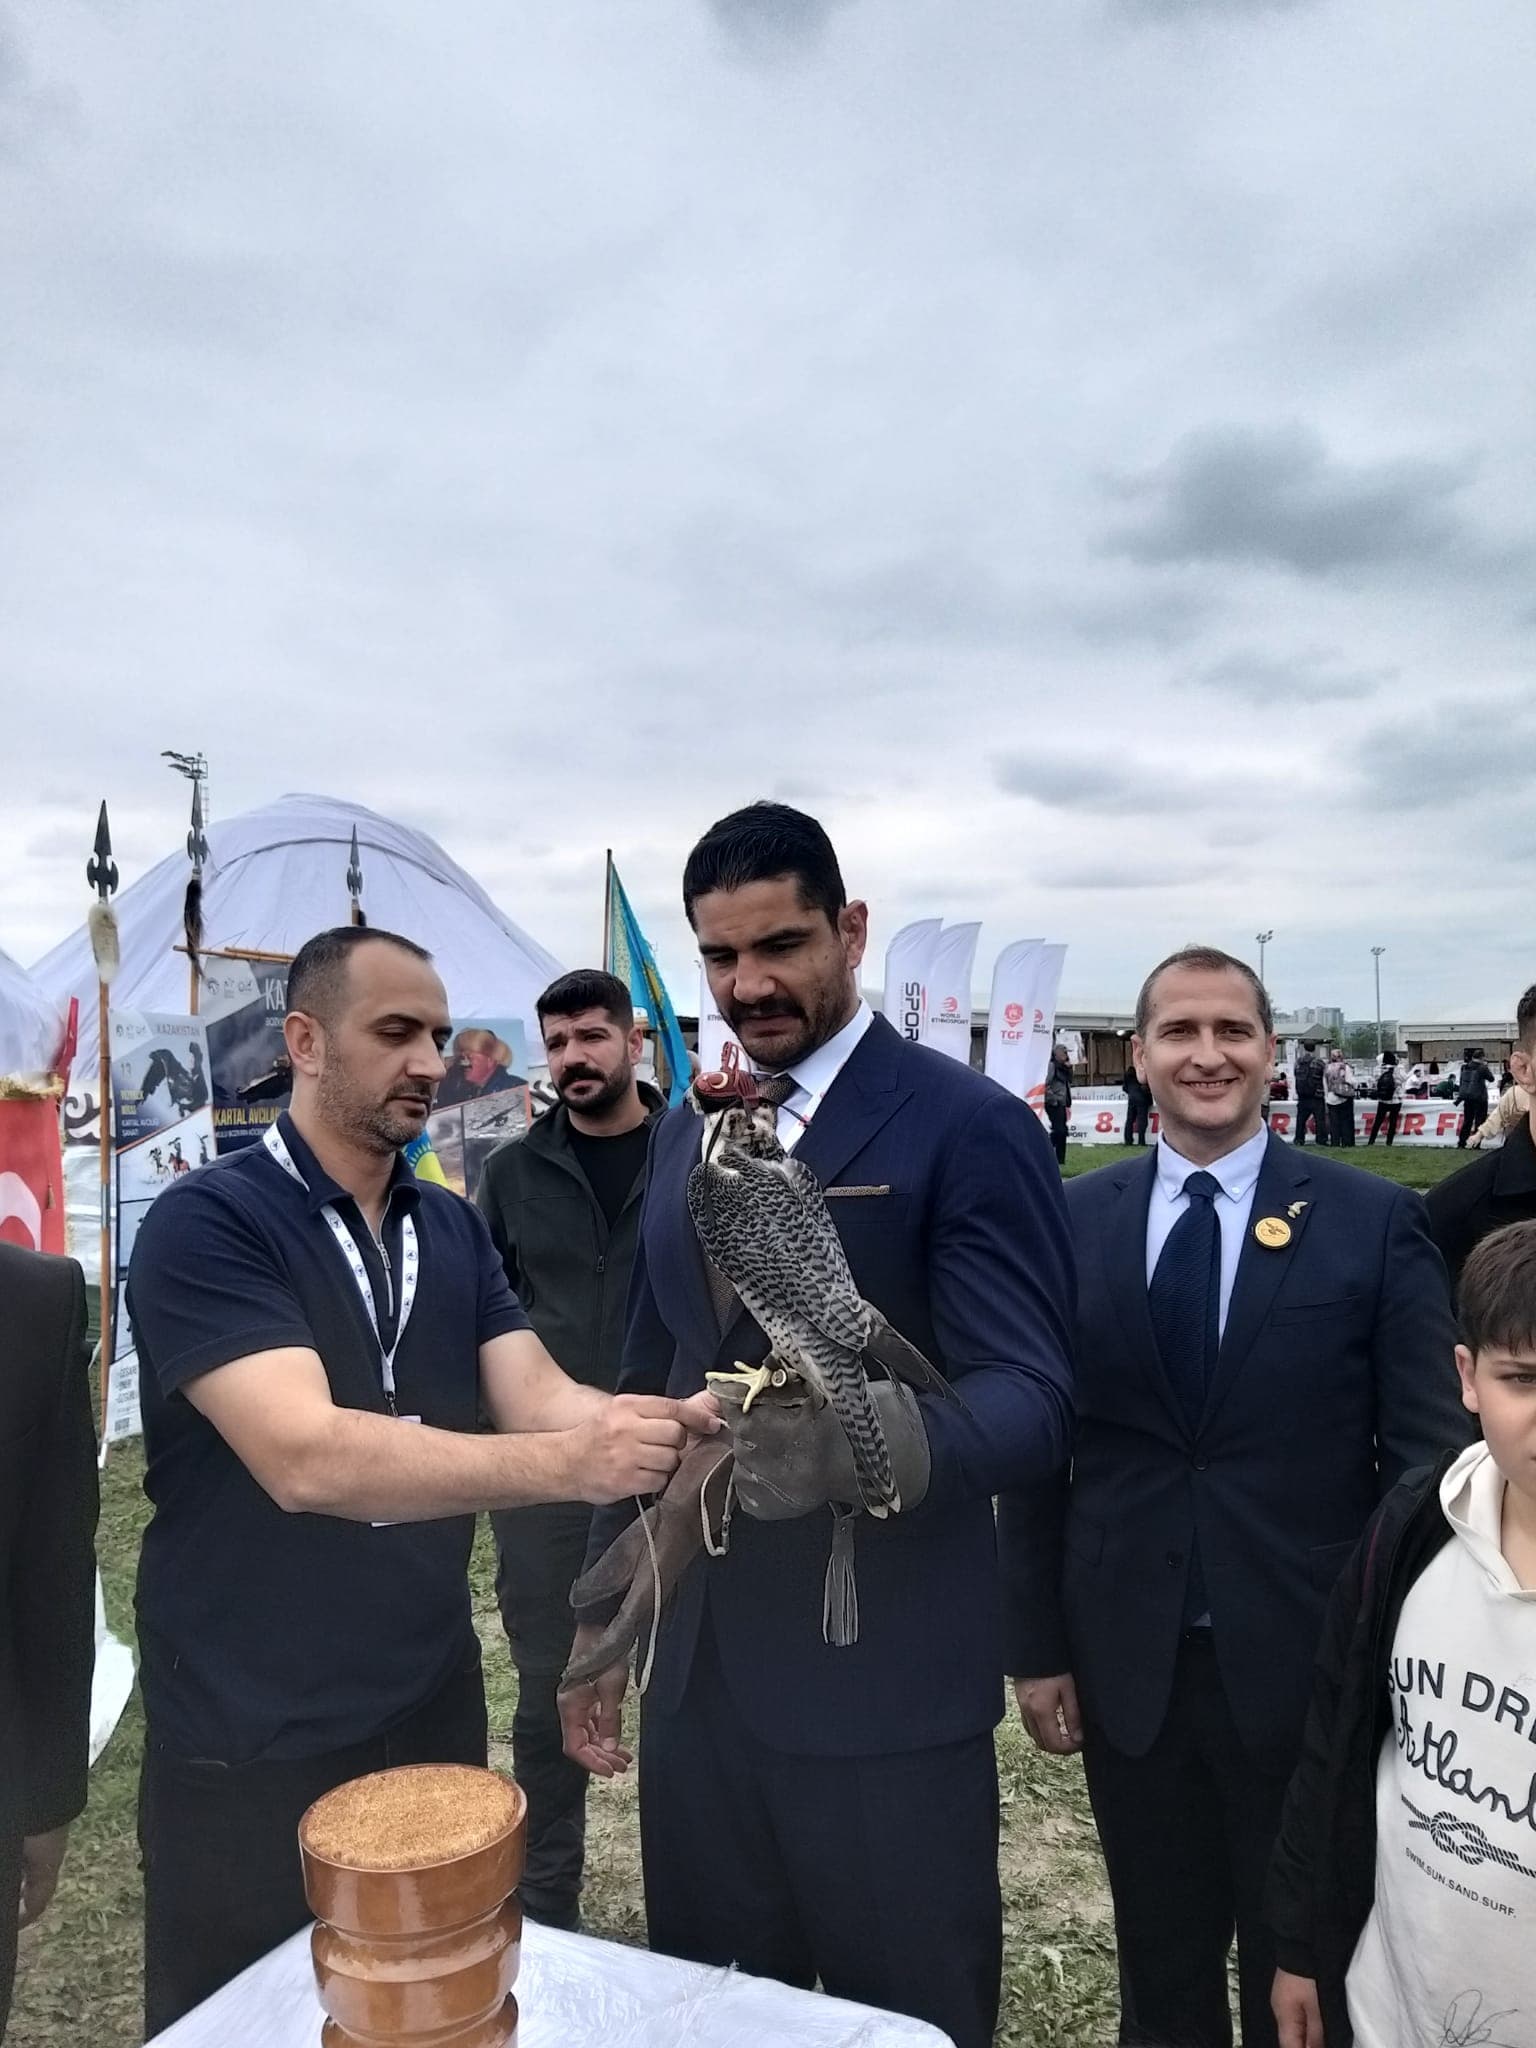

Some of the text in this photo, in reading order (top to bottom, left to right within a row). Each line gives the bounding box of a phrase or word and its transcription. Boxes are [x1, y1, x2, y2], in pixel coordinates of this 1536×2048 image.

[905, 982, 920, 1041] SPOR
[1000, 1030, 1024, 1040] TGF
[214, 1107, 247, 1126] KARTAL
[1095, 1112, 1120, 1133] 8.
